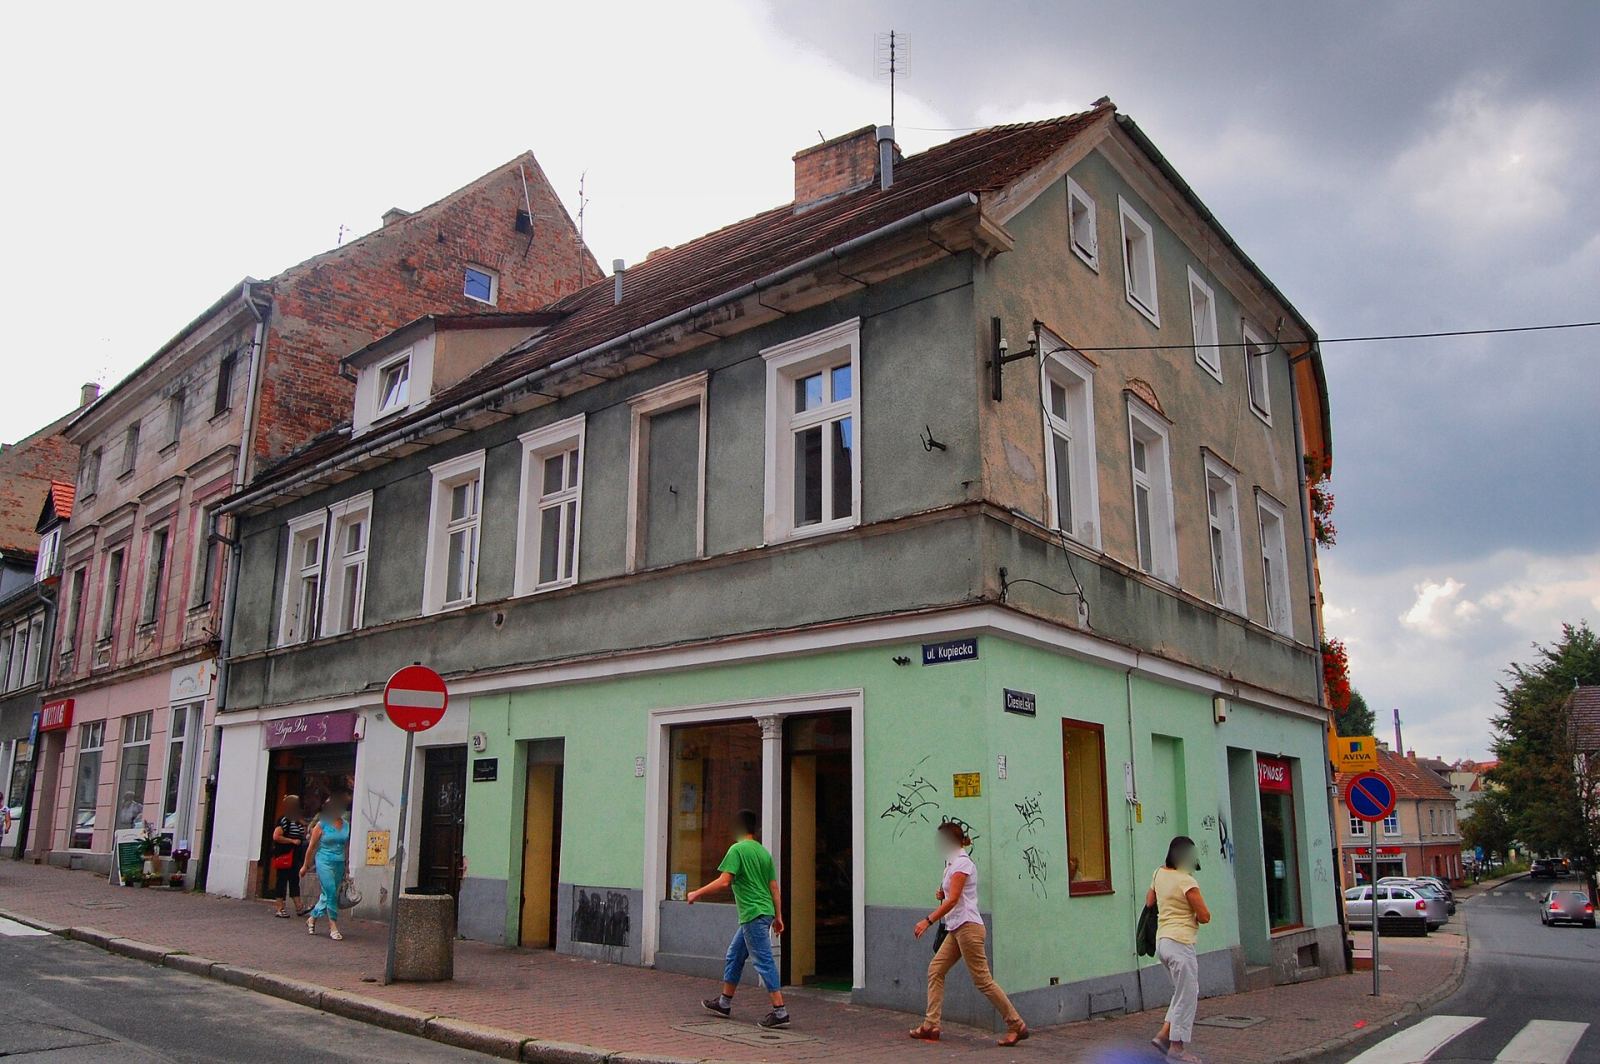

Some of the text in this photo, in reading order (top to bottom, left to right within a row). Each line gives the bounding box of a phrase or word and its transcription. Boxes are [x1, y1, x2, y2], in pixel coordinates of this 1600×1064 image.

[927, 643, 973, 661] ul. Kupiecka
[1343, 753, 1371, 761] AVIVA
